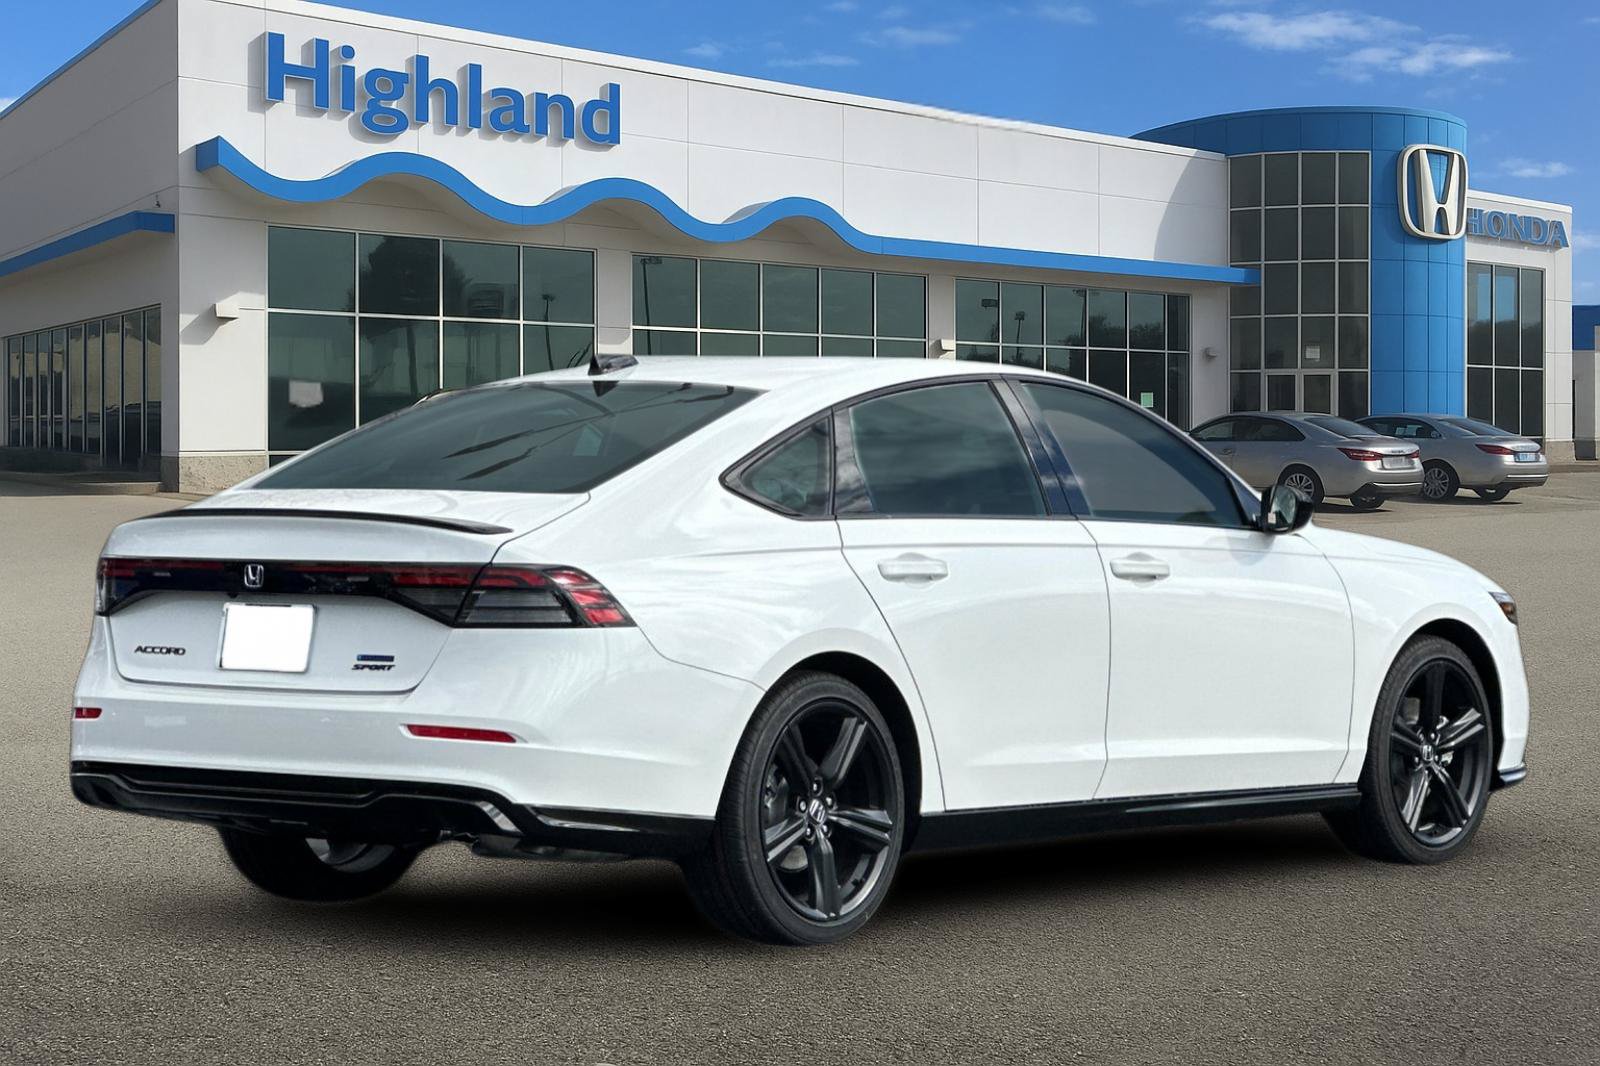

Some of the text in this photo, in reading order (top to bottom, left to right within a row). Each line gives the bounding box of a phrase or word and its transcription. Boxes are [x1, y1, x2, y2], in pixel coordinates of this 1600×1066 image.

[266, 31, 620, 145] Highland
[1467, 208, 1569, 248] HONDA
[134, 645, 186, 656] ACCORD
